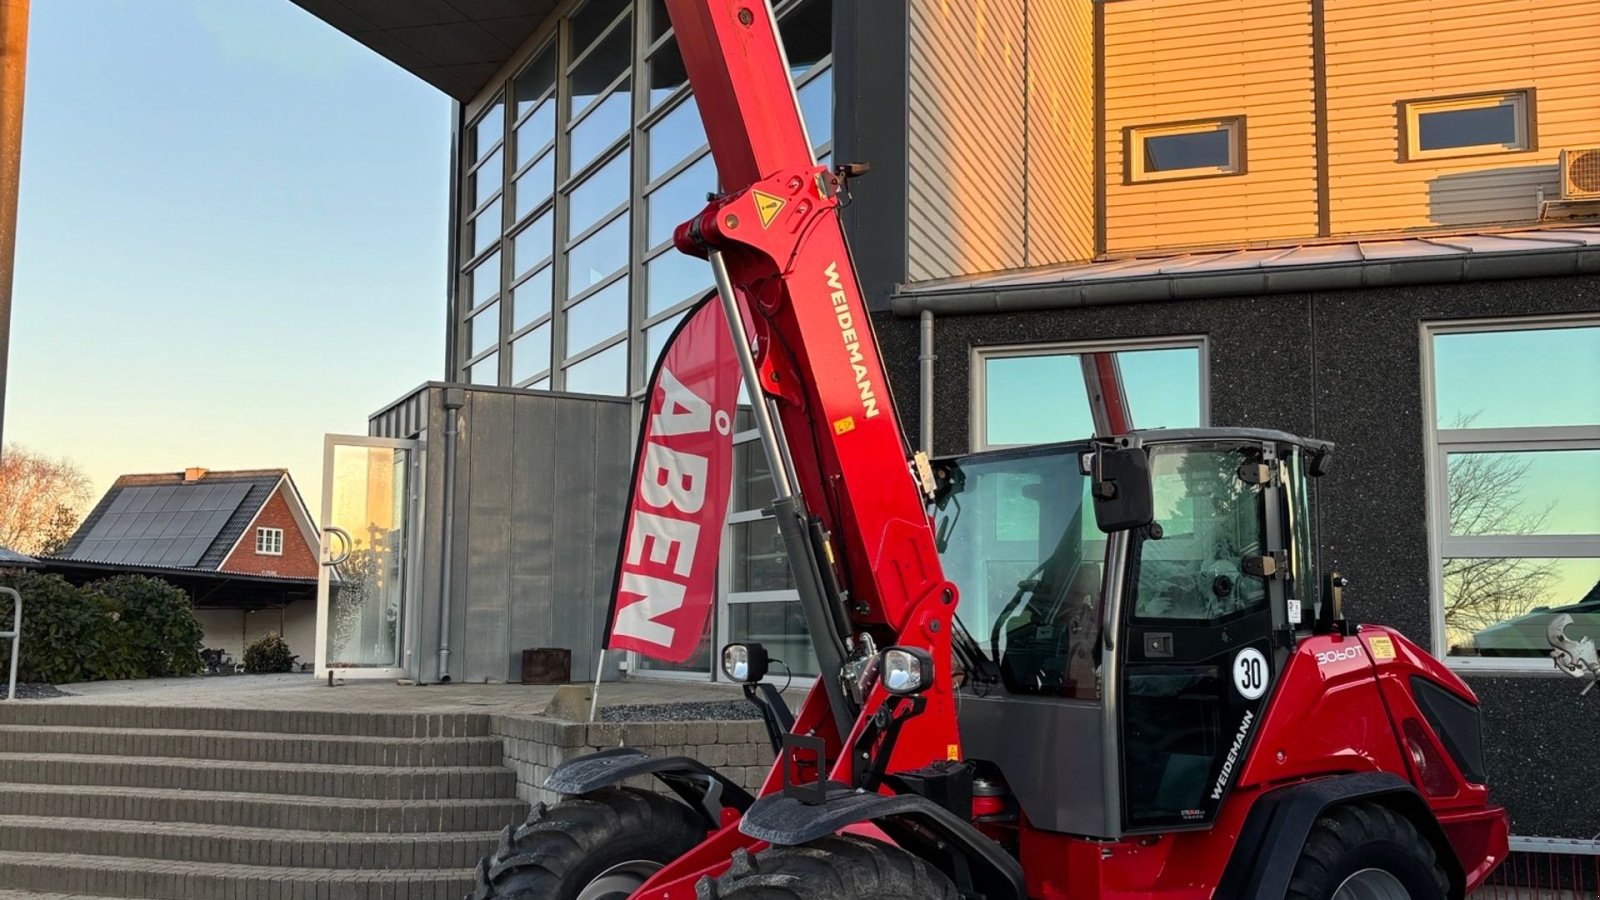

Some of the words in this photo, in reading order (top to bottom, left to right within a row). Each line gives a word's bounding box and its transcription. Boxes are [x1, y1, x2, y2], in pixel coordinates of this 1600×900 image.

[824, 261, 880, 419] WEIDEMANN
[613, 366, 731, 648] ÅBEN
[1240, 657, 1262, 690] 30
[1315, 645, 1362, 665] 3060T
[1211, 709, 1254, 801] WEIDEMANN
